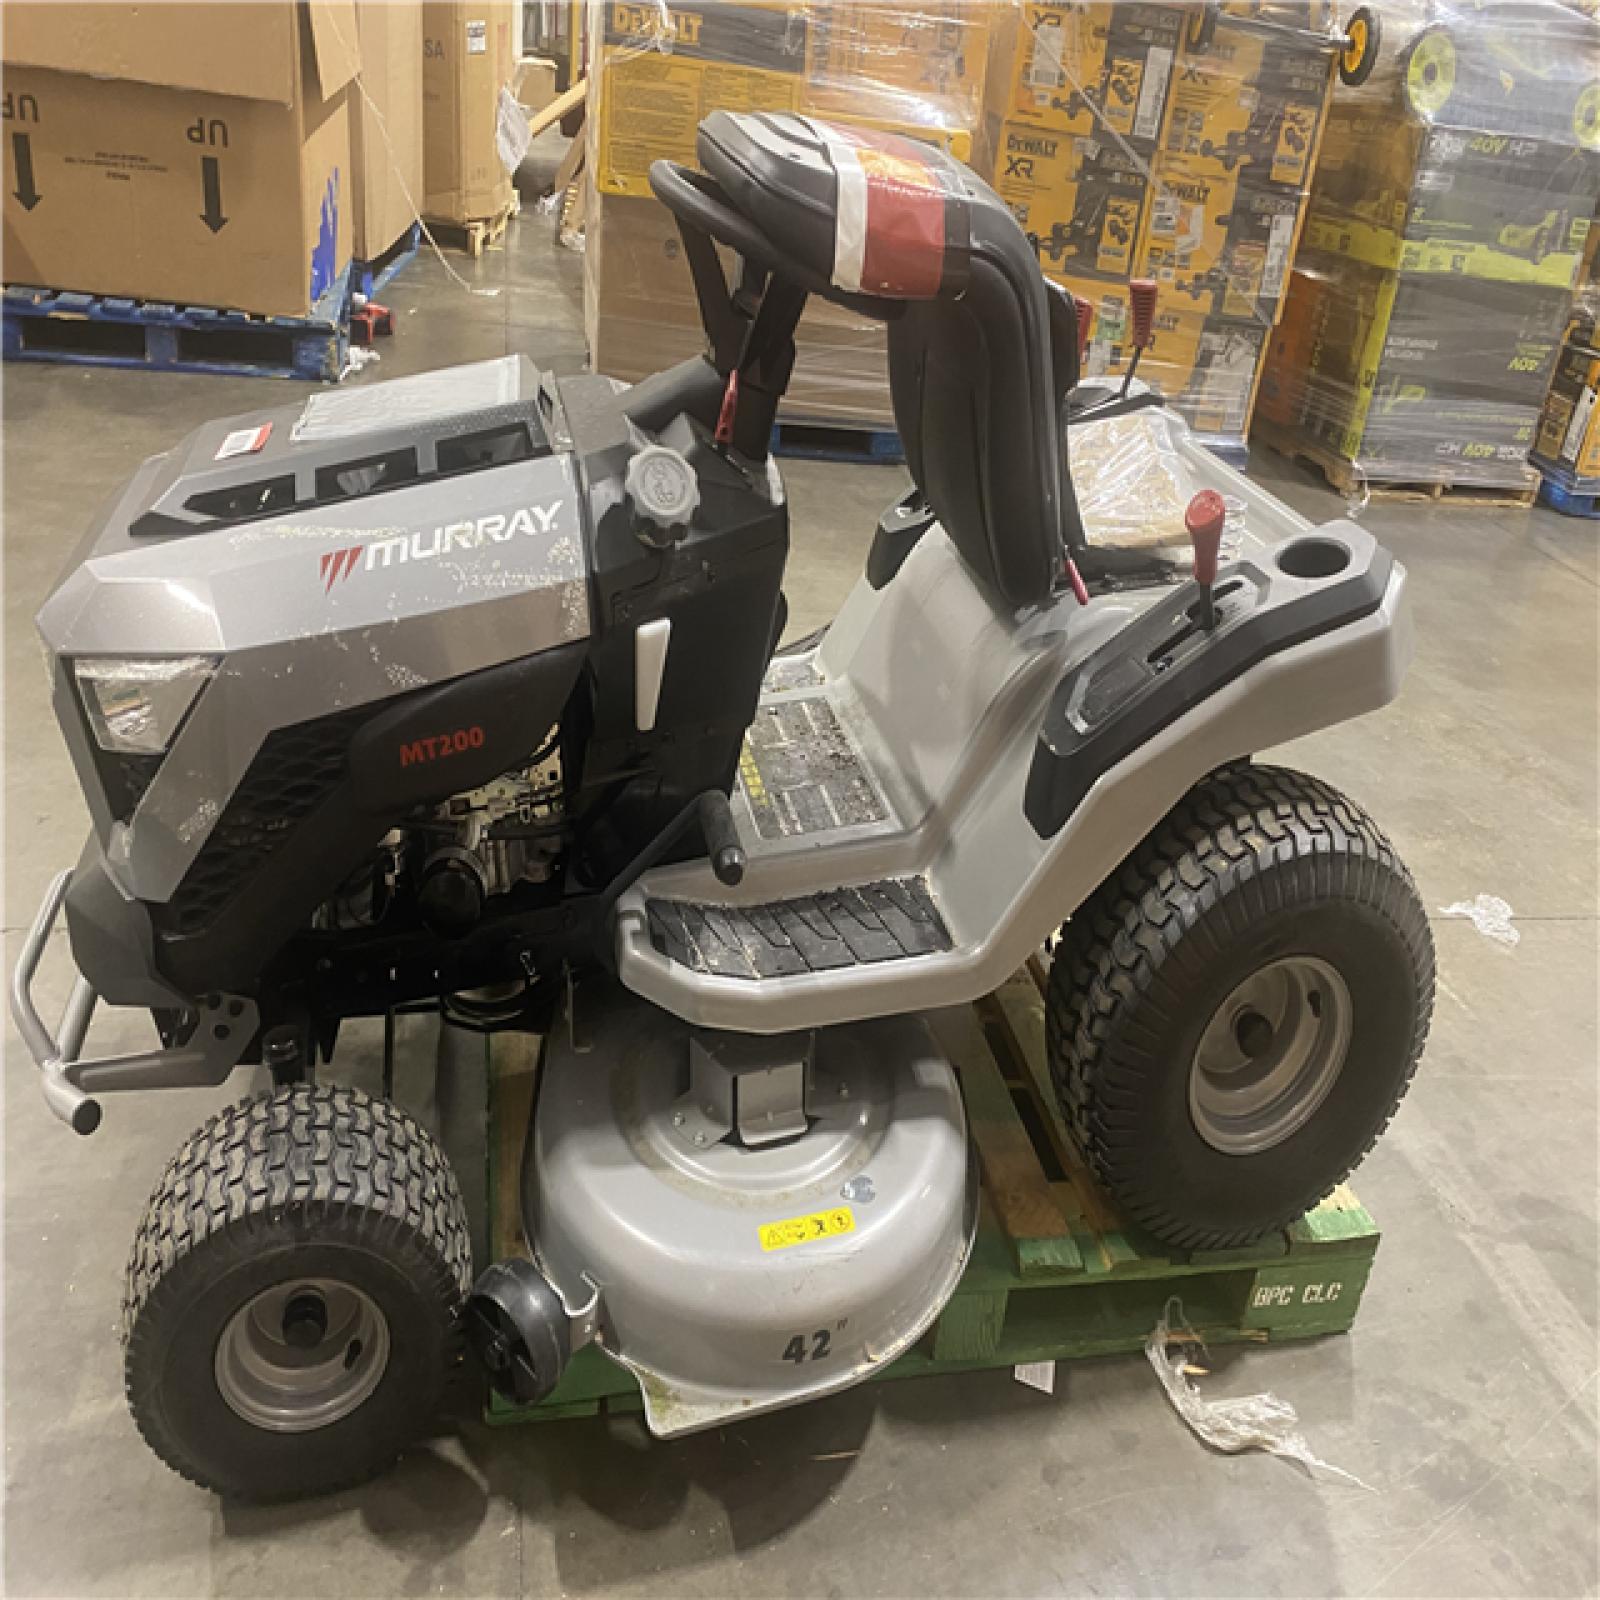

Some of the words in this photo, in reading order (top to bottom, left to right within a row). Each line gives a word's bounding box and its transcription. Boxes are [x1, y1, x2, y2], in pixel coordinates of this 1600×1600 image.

[187, 117, 228, 148] UP
[1004, 154, 1033, 177] XR
[399, 725, 485, 768] MT200
